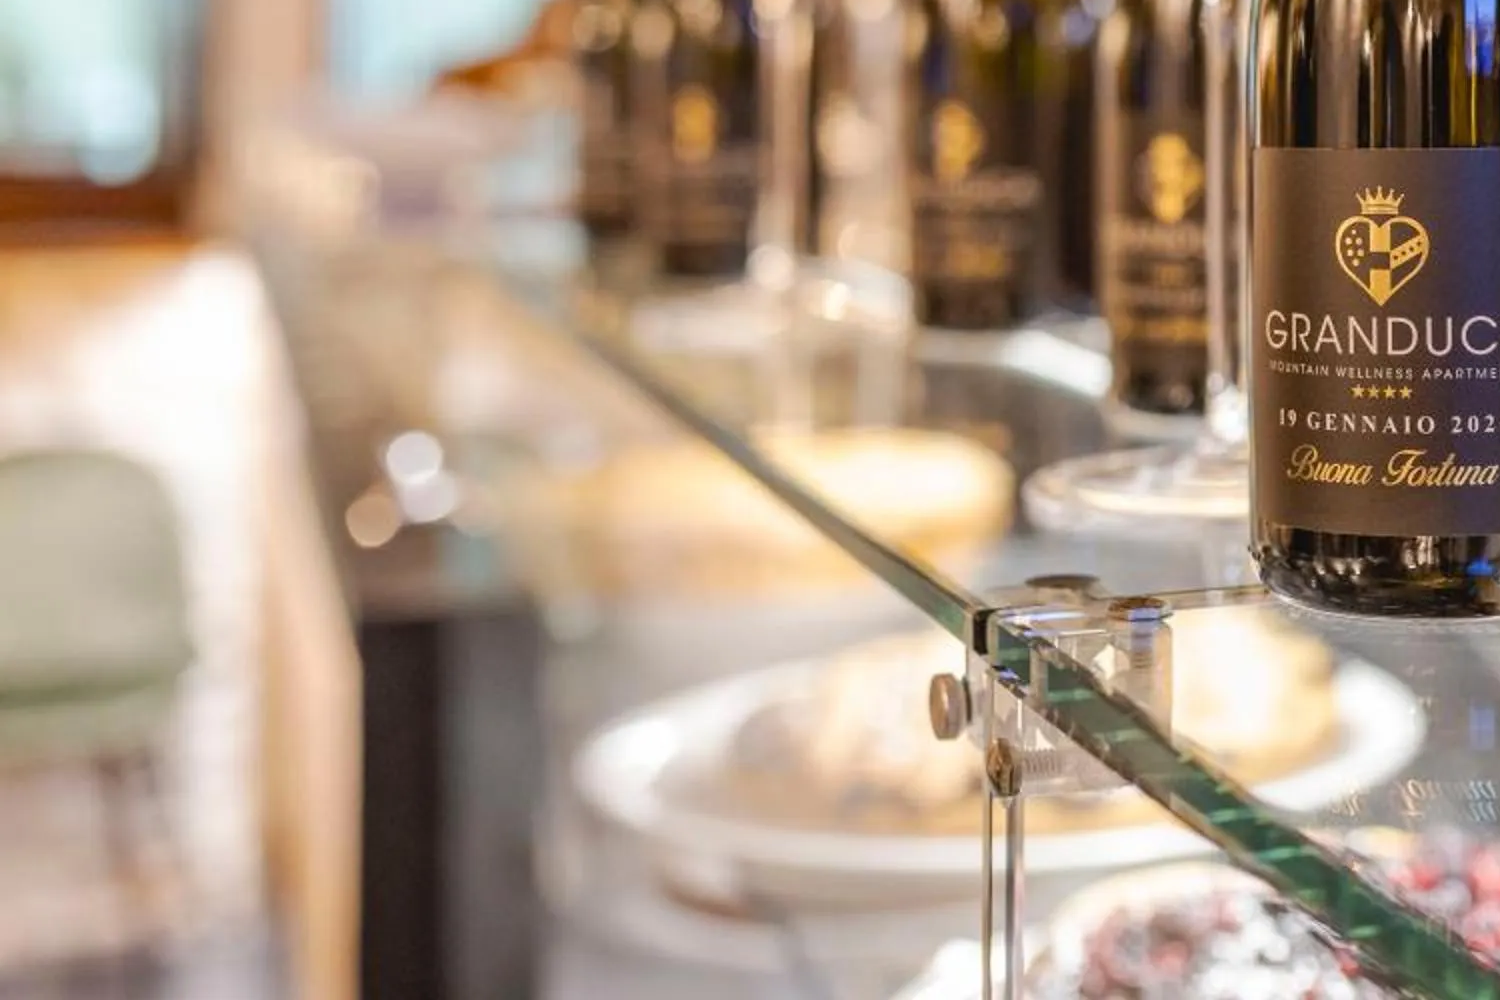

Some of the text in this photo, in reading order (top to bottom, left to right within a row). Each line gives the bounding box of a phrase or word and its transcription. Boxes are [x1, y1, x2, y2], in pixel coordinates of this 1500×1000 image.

[1269, 359, 1330, 378] MOUNTAIN
[1335, 365, 1413, 381] WELLNESS
[1278, 408, 1298, 428] 19
[1306, 411, 1437, 435] GENNAIO
[1286, 443, 1500, 488] Buona Fortuna
